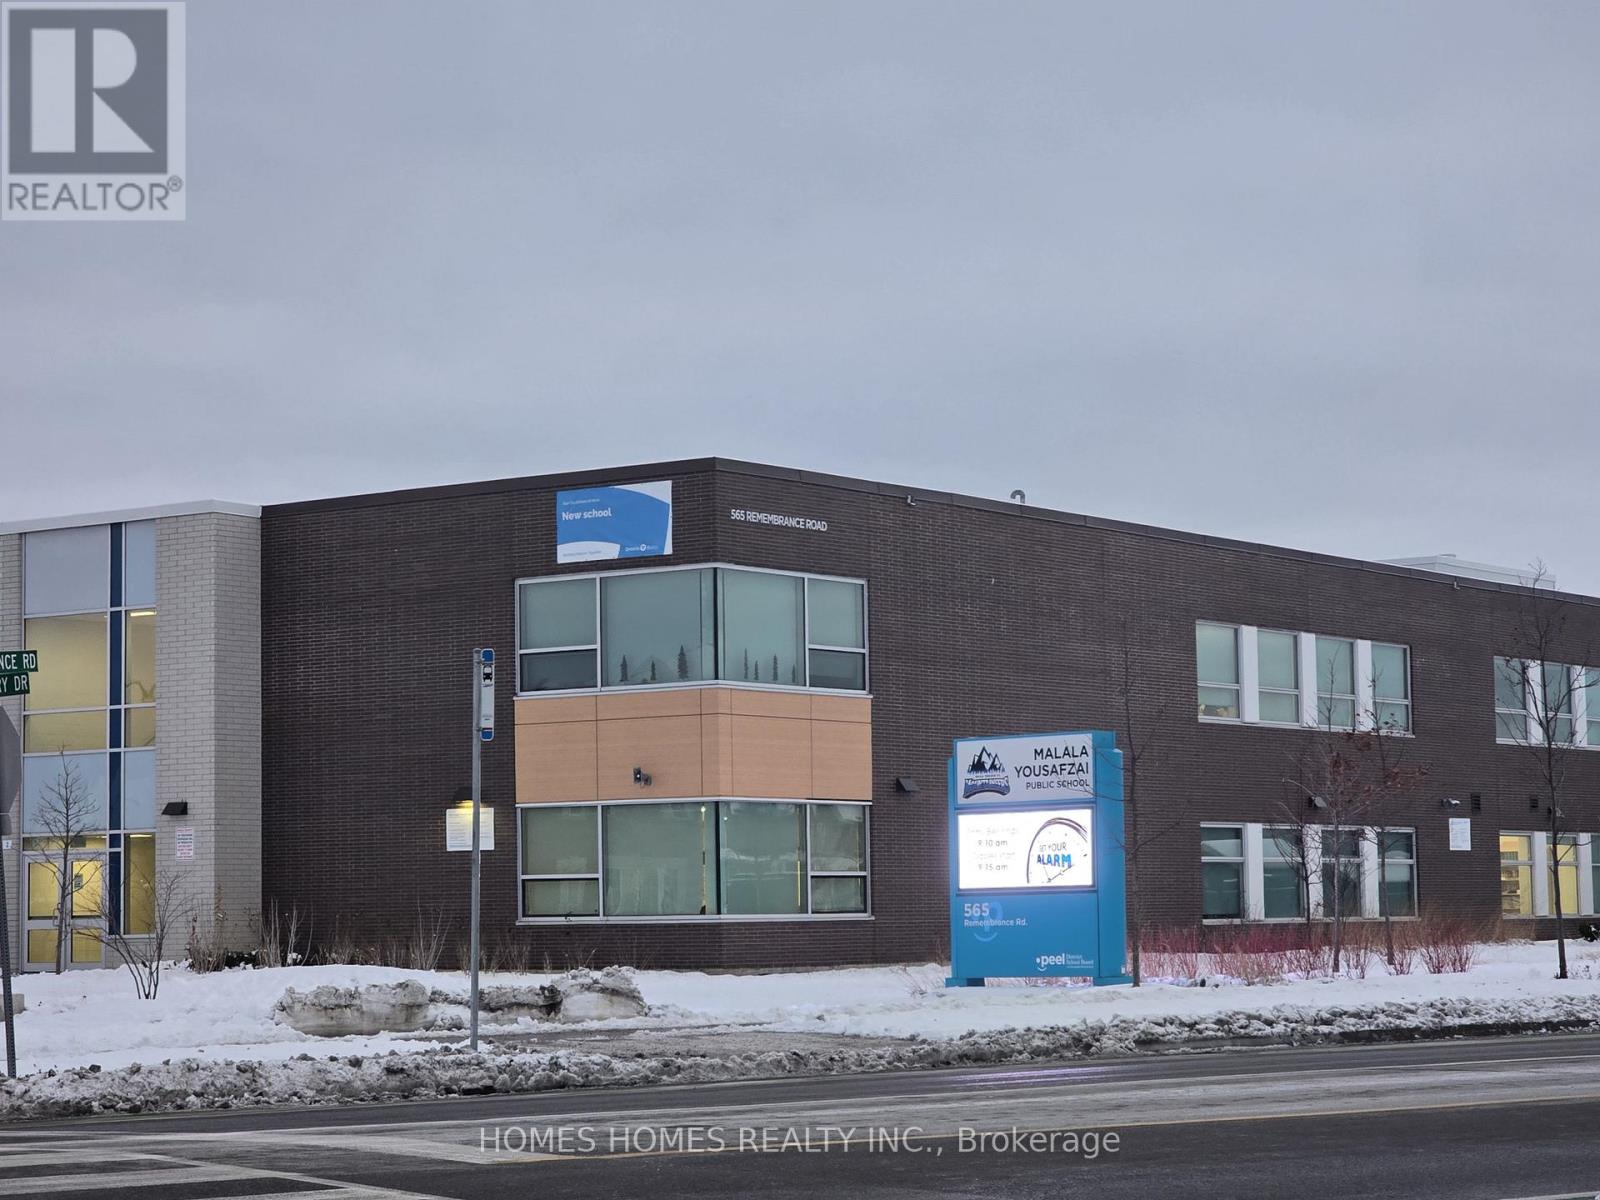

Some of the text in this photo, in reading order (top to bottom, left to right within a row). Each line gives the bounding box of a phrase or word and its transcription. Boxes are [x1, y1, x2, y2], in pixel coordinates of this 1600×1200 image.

[562, 507, 612, 521] New school
[730, 509, 828, 532] 565 REMEMBRANCE ROAD
[22, 653, 36, 669] RD
[0, 674, 28, 692] Y DR
[1034, 745, 1089, 761] MALALA
[1014, 762, 1089, 778] YOUSAFZAI
[1026, 779, 1090, 790] PUBLIC SCHOOL
[1036, 853, 1071, 868] ALARM
[963, 902, 989, 917] 565
[963, 917, 1028, 928] Remembrance Rd.
